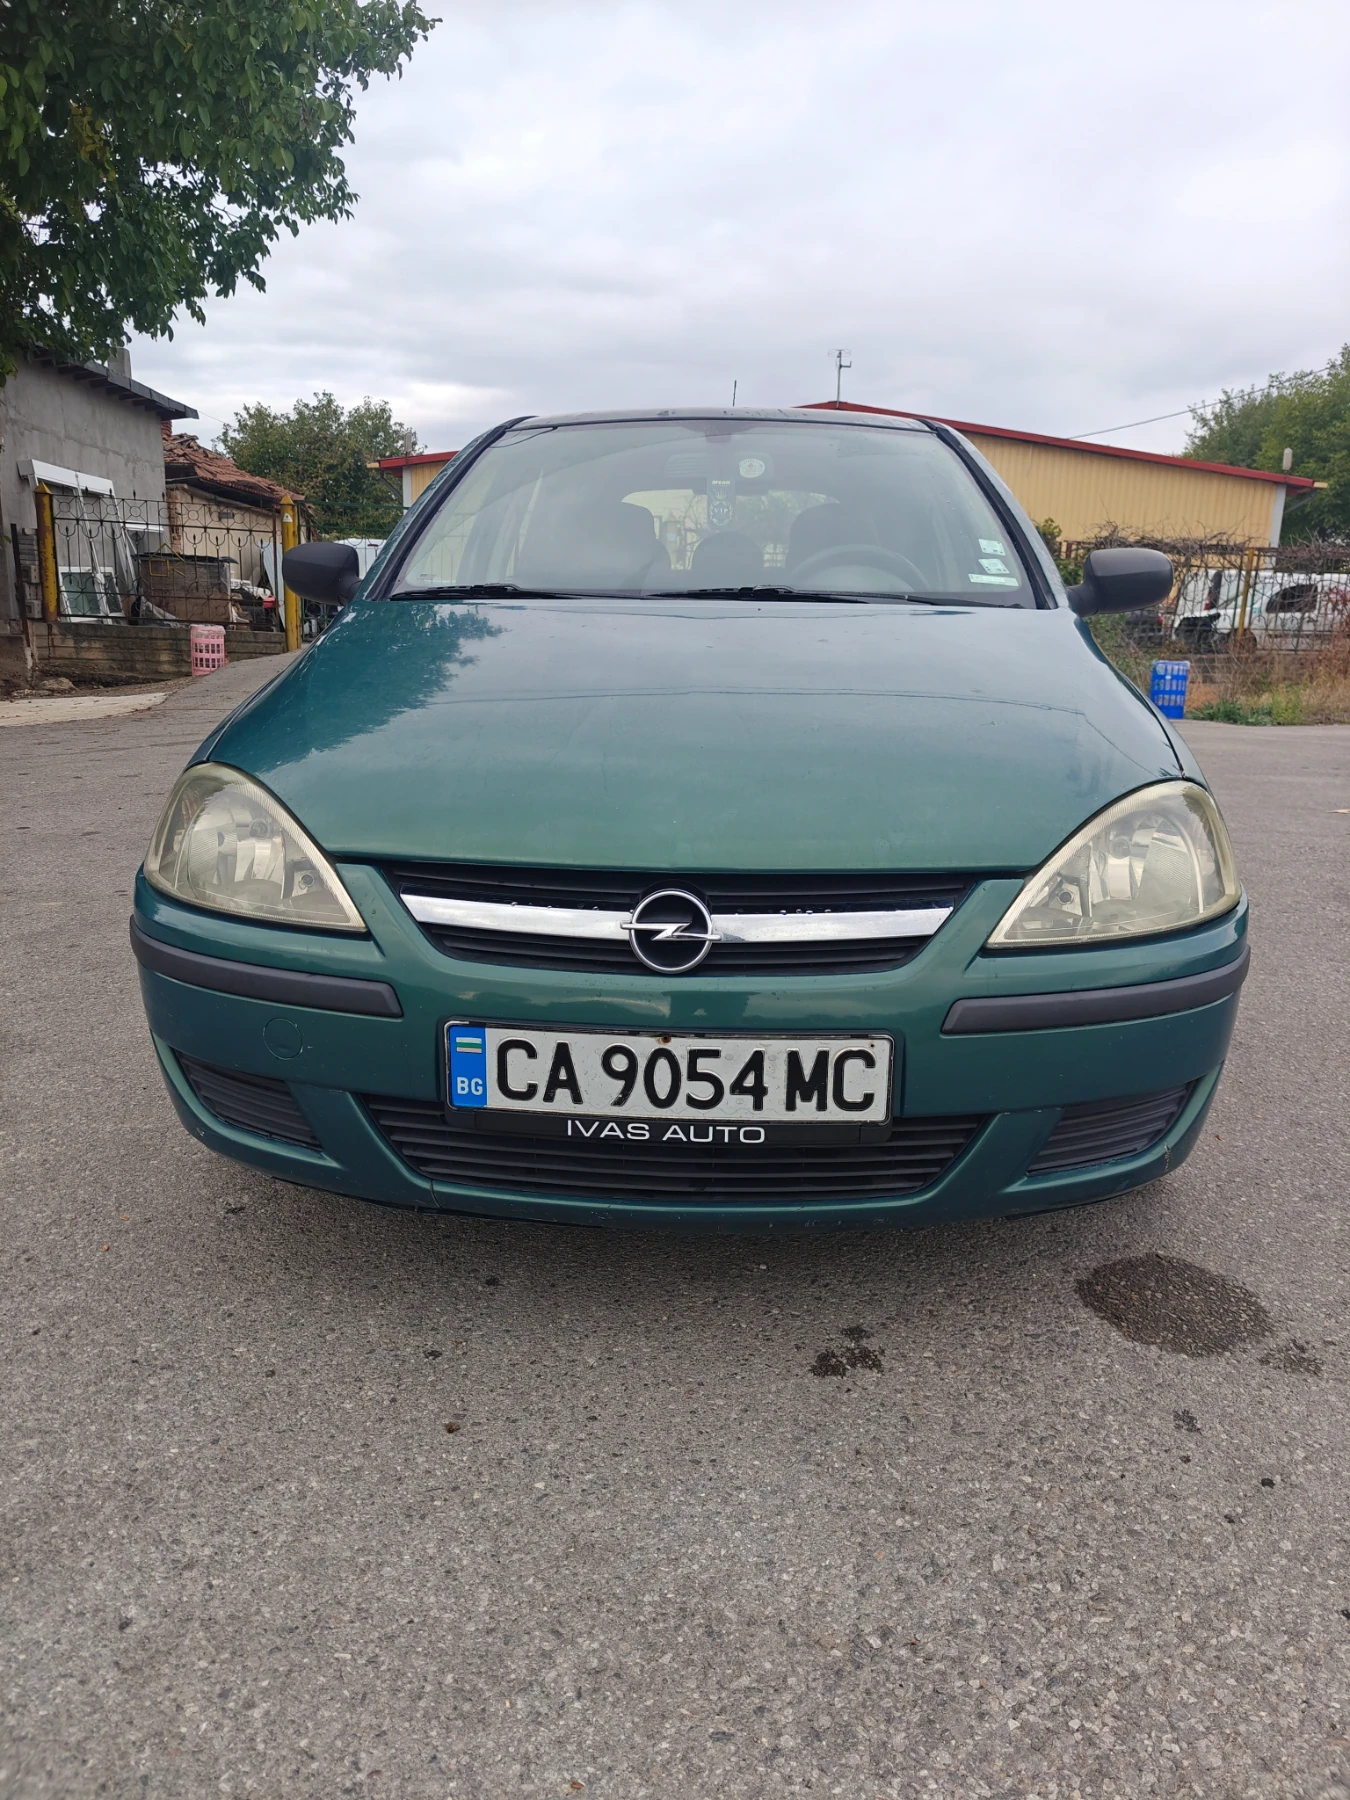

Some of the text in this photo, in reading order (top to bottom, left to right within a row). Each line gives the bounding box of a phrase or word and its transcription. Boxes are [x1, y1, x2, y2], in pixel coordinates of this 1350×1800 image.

[456, 1076, 483, 1096] BG
[496, 1038, 877, 1113] CA 9054 MC
[567, 1119, 766, 1144] IVAS AUTO
